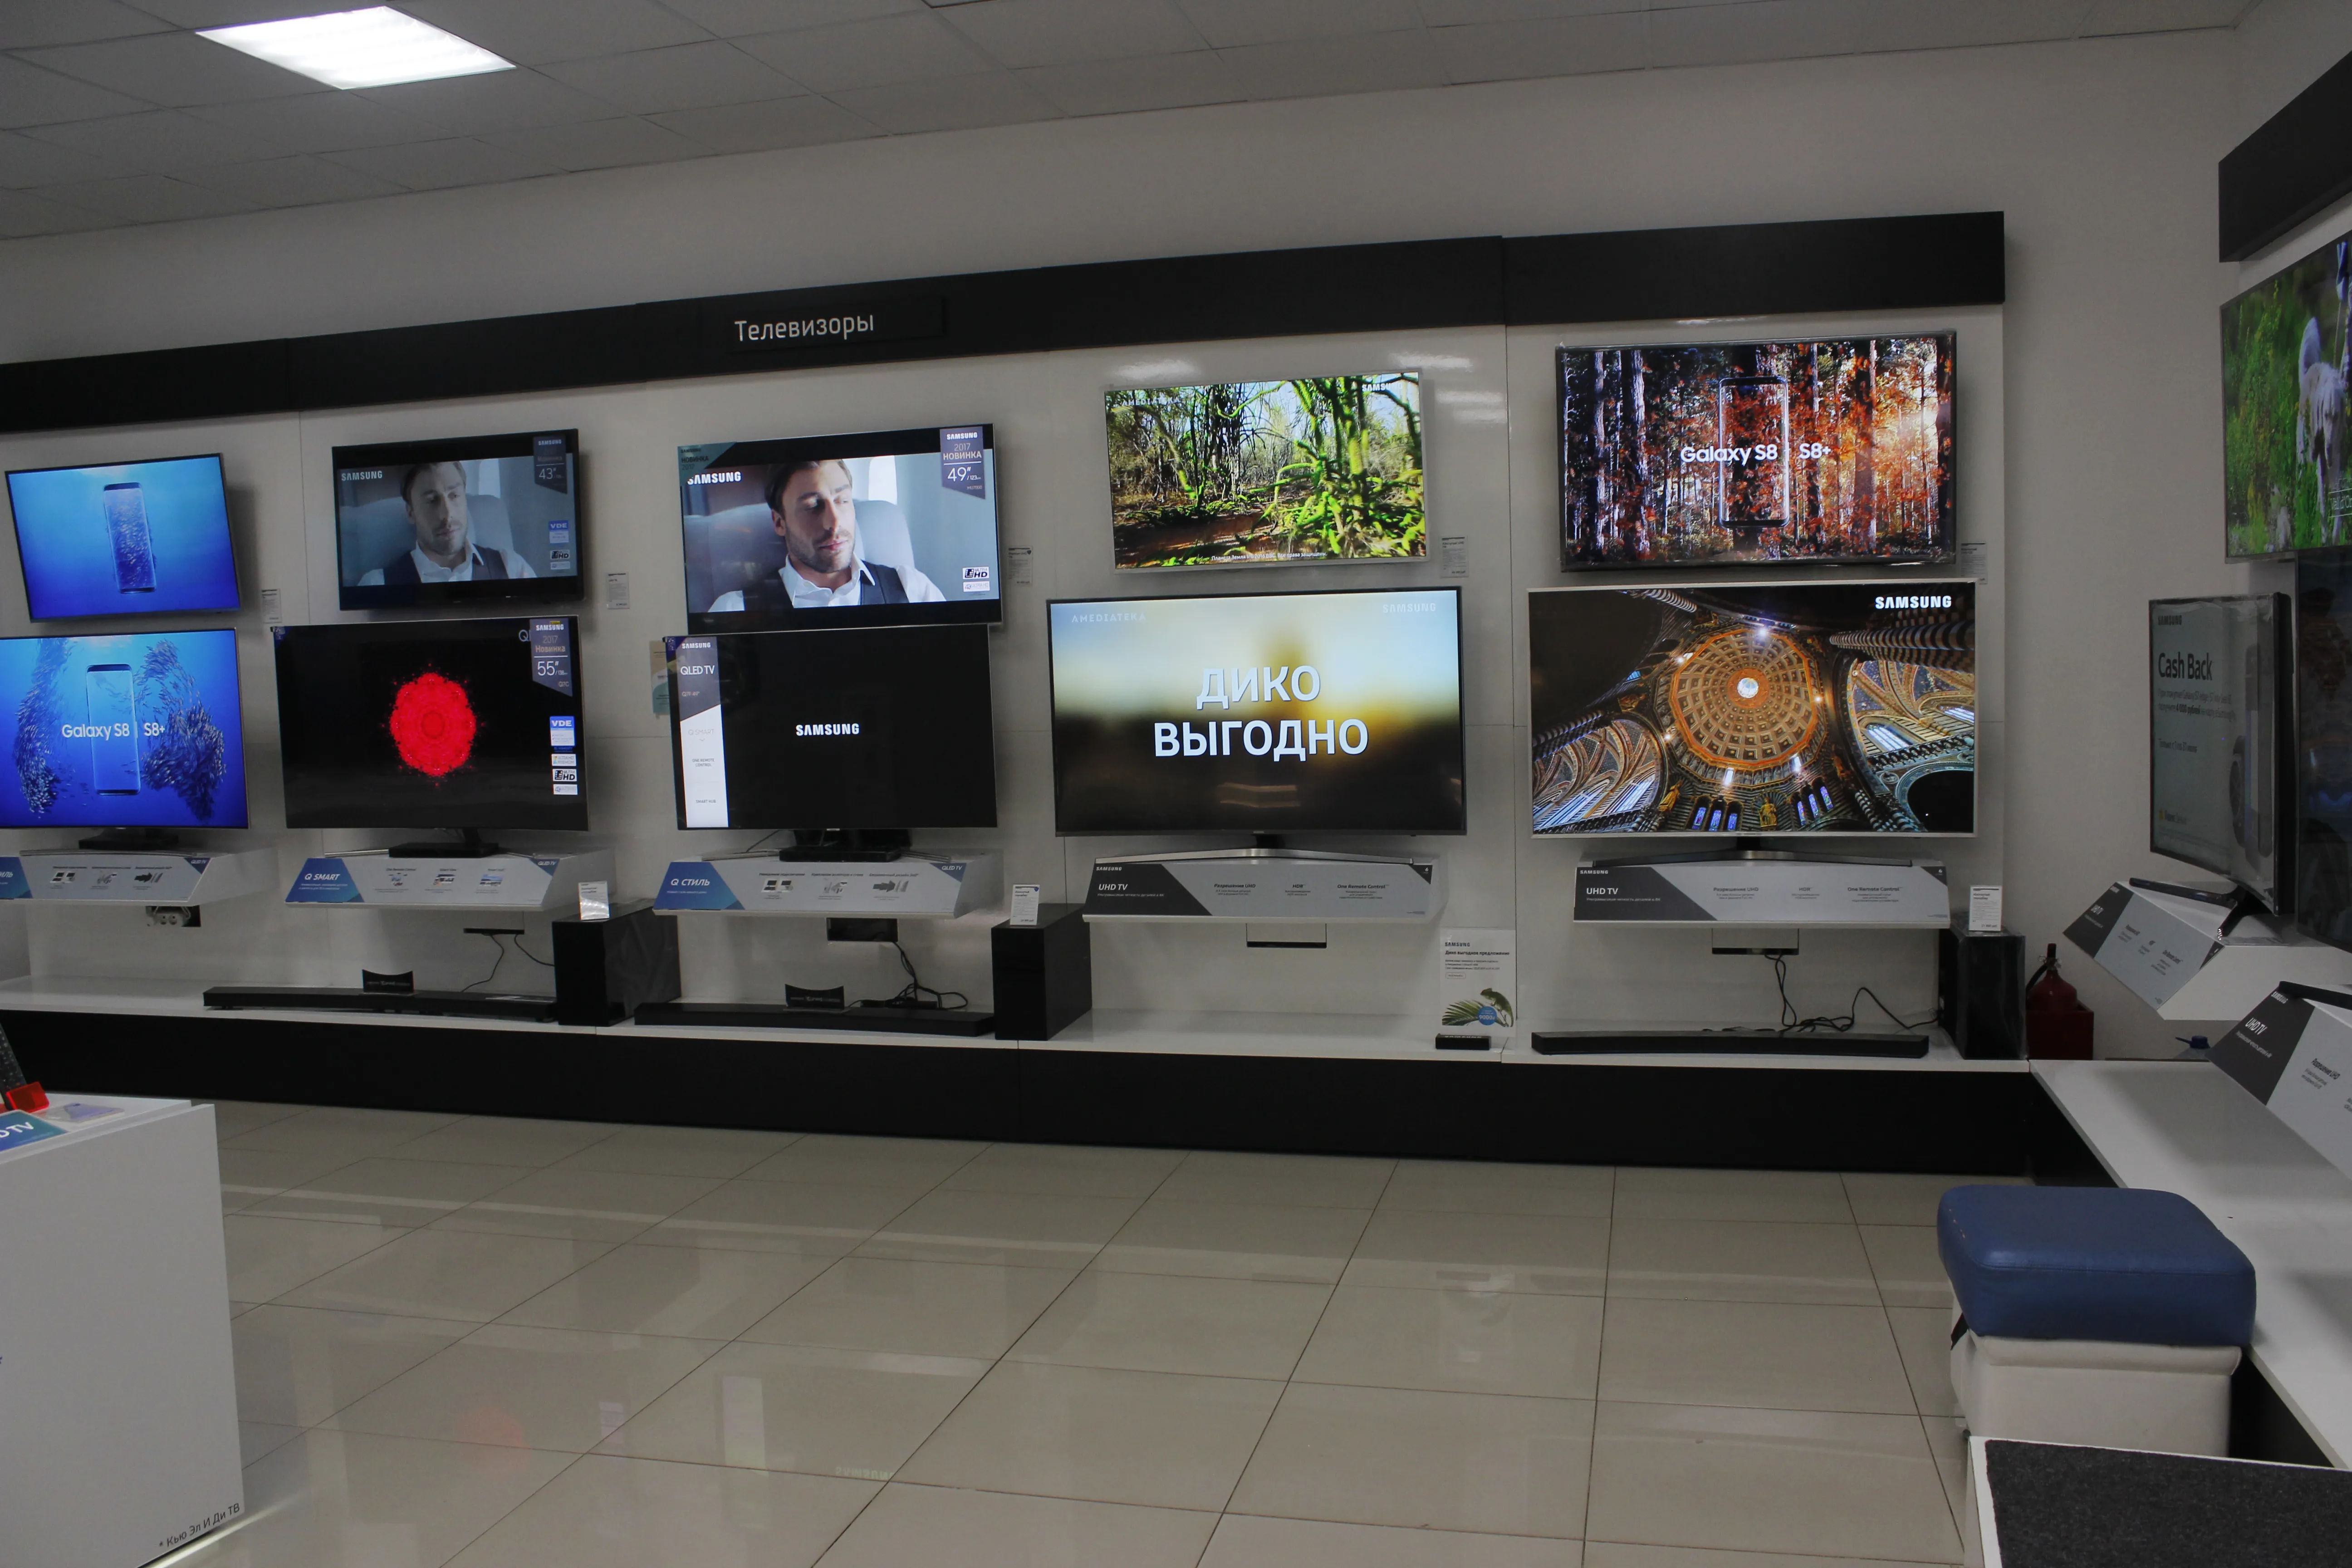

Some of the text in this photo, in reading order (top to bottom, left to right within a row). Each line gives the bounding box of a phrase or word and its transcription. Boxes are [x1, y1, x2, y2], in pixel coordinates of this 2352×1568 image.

[735, 315, 873, 342] Телевизоры
[946, 432, 978, 440] SAMSUNG
[954, 443, 971, 451] 2017
[943, 451, 982, 460] НОВИНКА
[1680, 442, 1831, 466] Galaxy S8 S8+
[341, 470, 382, 481] SAMSUNG
[687, 471, 741, 485] SAMSUNG
[1382, 602, 1436, 613] SAMSUNG
[1875, 595, 1952, 609] SAMSUNG
[1072, 612, 1146, 622] AMEDIATEKA
[2158, 615, 2182, 626] SAMSUNG
[543, 636, 558, 644] 2017
[681, 665, 715, 675] QLED TV
[2158, 651, 2213, 681] Cash Back
[1196, 665, 1321, 710] ДИКО
[62, 722, 166, 741] Galaxy S8 S8+
[795, 723, 860, 736] SAMSUNG
[1154, 718, 1369, 762] ВЫГОДНО
[2271, 991, 2288, 1004] SAMSUNG
[2245, 1017, 2268, 1035] UHD TV
[6, 1121, 34, 1133] TV
[167, 1503, 240, 1547] Кью Эл И Ди ТВ
